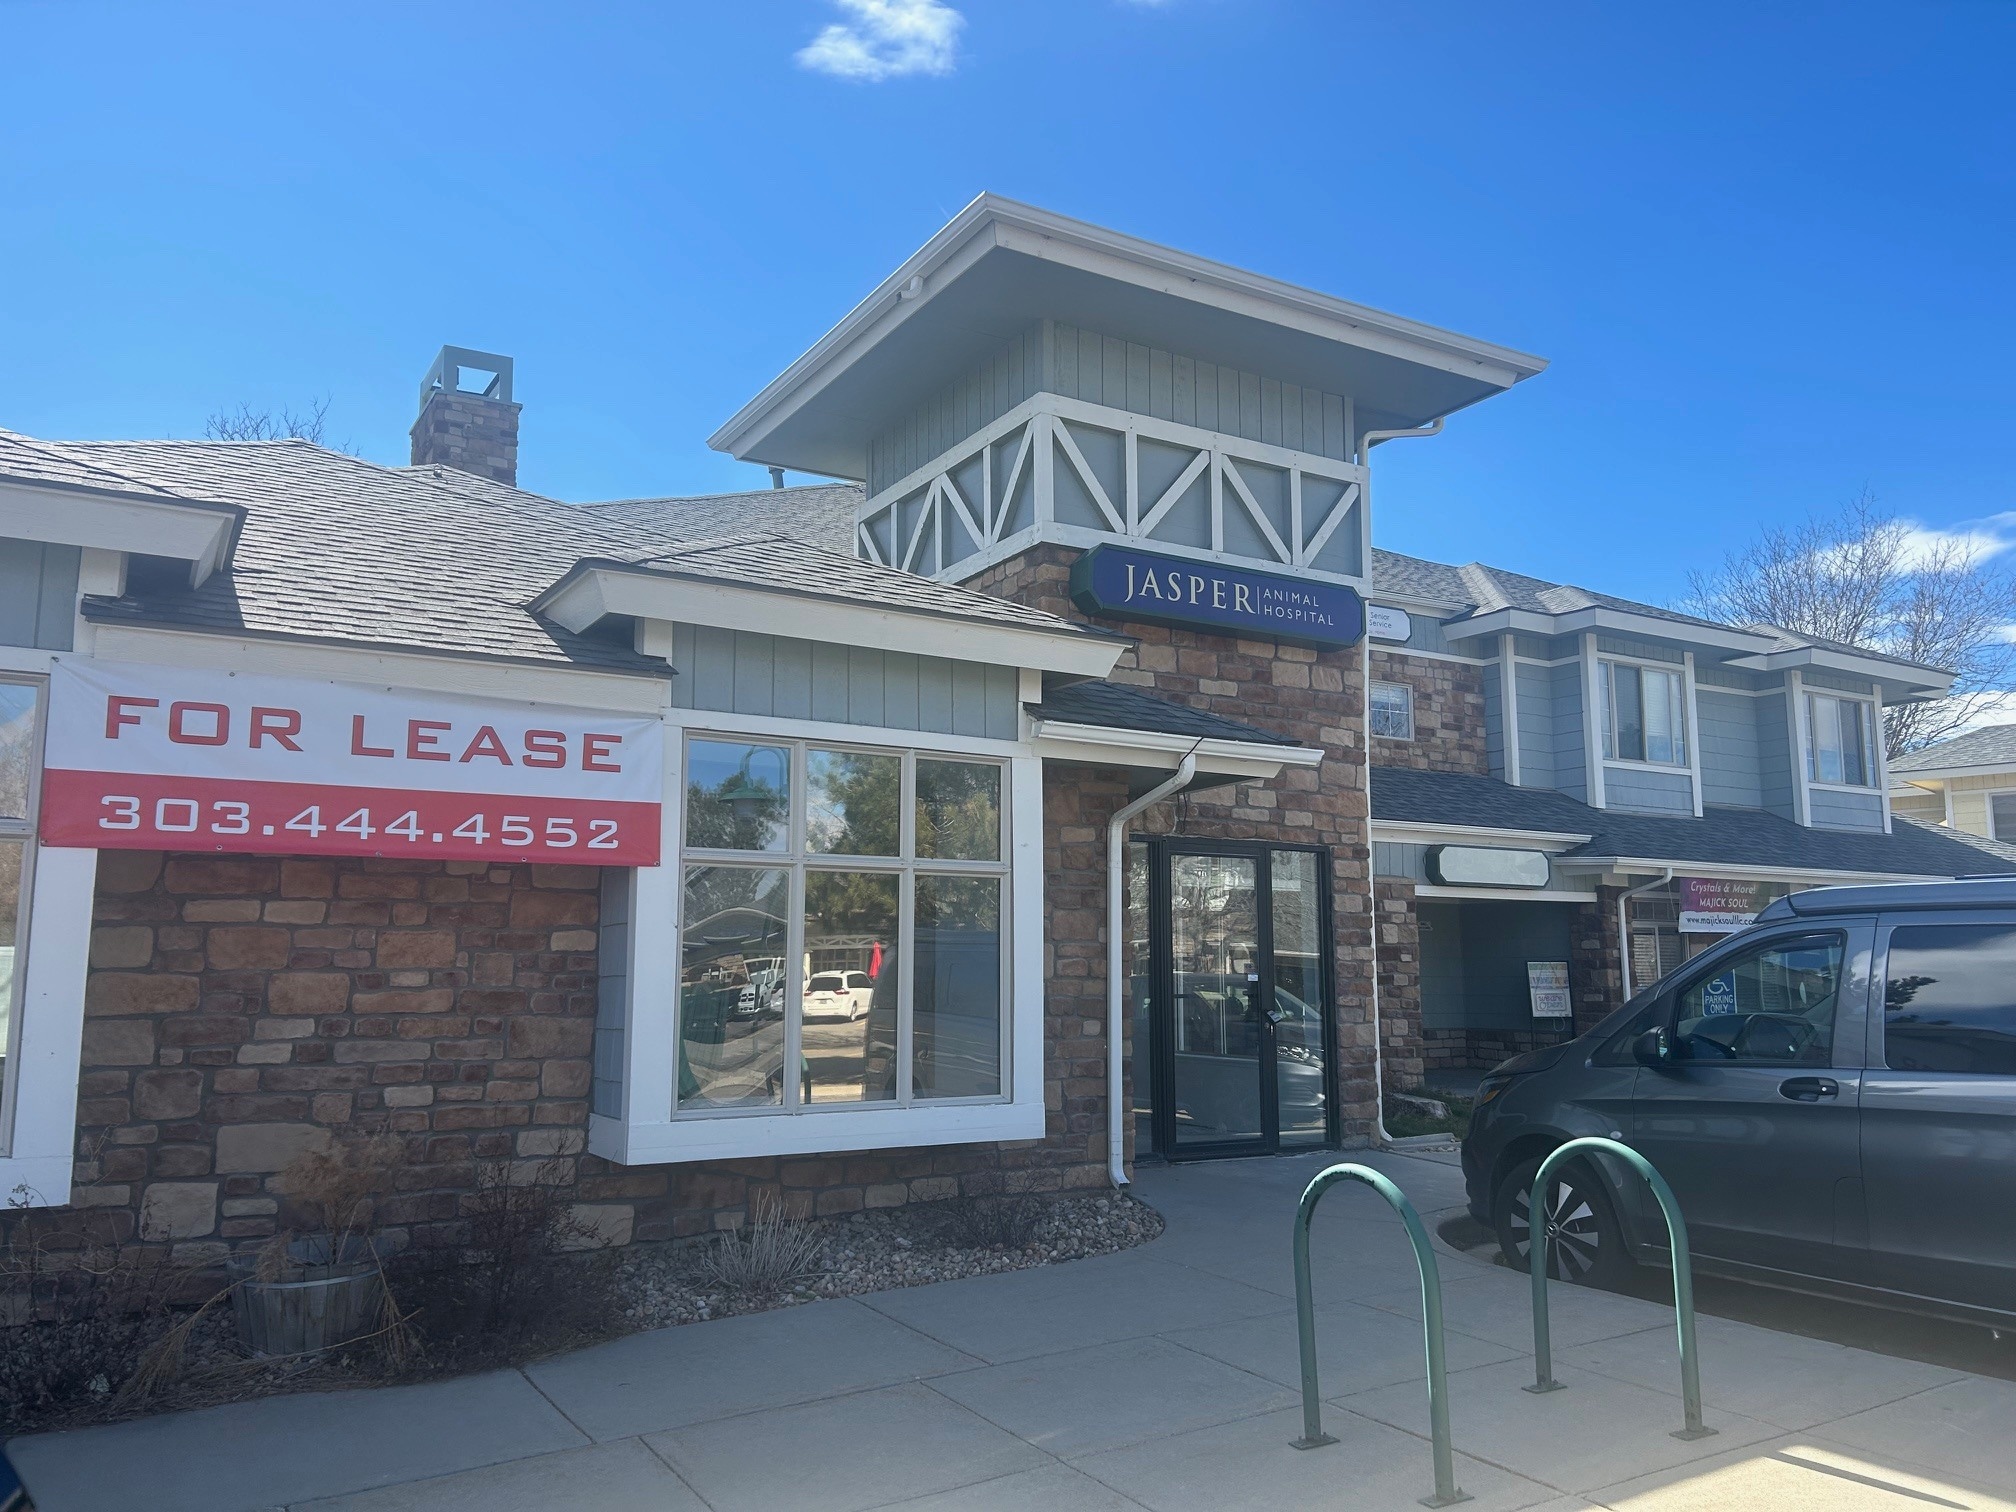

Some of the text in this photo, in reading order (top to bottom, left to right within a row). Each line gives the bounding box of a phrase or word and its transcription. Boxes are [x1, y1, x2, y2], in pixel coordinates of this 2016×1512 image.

[1124, 564, 1256, 614] JASPER
[1263, 588, 1319, 607] ANIMAL
[1264, 604, 1334, 626] HOSPITAL
[1370, 612, 1389, 620] Senior
[105, 694, 623, 773] FOR LEASE
[98, 795, 620, 850] 303.444.4552
[1690, 881, 1756, 895] Crystals & More!
[1699, 897, 1749, 908] MAJICK SOUL
[1686, 914, 1753, 927] www.majicksoulllc.co
[1705, 995, 1733, 1004] PARKING
[1710, 1004, 1728, 1013] ONLY
